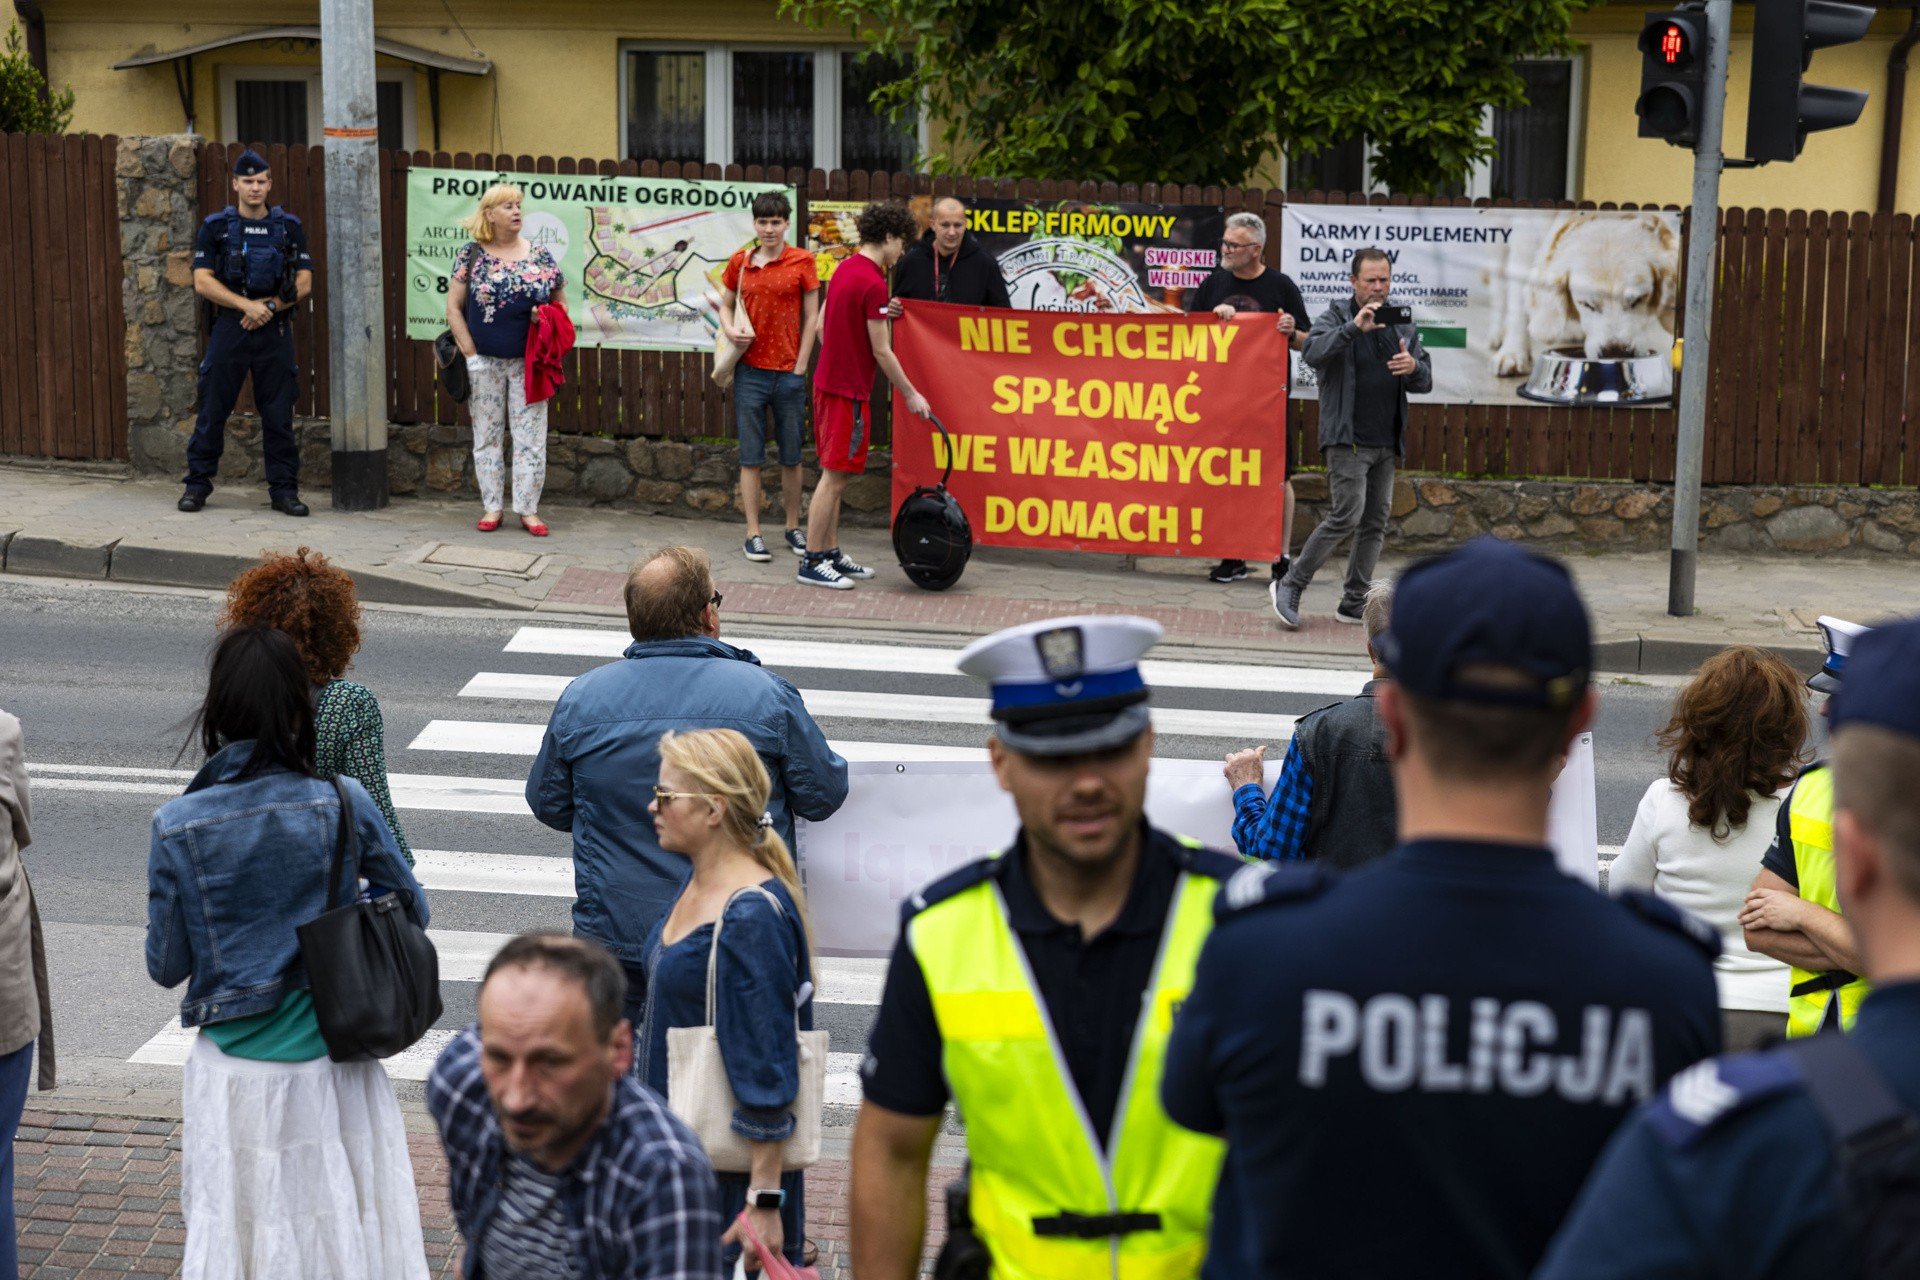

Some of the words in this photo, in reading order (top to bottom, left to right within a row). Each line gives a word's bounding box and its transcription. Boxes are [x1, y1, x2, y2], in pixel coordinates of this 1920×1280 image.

[432, 177, 628, 203] PROJTOWANIE
[635, 186, 763, 209] OGRODÓW
[244, 226, 269, 235] POLICJA
[423, 225, 470, 240] ARCHI
[964, 208, 1039, 234] SKLEP
[1045, 212, 1176, 239] FIRMOWY
[1301, 223, 1371, 240] KARMY
[1375, 225, 1380, 240] I
[1385, 226, 1513, 243] SUPLEMENTY
[1146, 249, 1215, 267] SWOJSKIE
[1301, 247, 1338, 263] DLA
[1343, 245, 1400, 263] PW
[1300, 285, 1353, 294] STARANNI
[1390, 286, 1428, 297] ANYCH
[1430, 287, 1468, 298] MAREK
[958, 317, 1031, 354] NIE
[1053, 322, 1239, 363] CHCEMY
[992, 371, 1202, 435] SPŁONĄĆ
[932, 432, 998, 474] WE
[1008, 437, 1261, 487] WŁASNYCH
[985, 496, 1180, 544] DOMACH
[1299, 988, 1655, 1106] POLICJA
